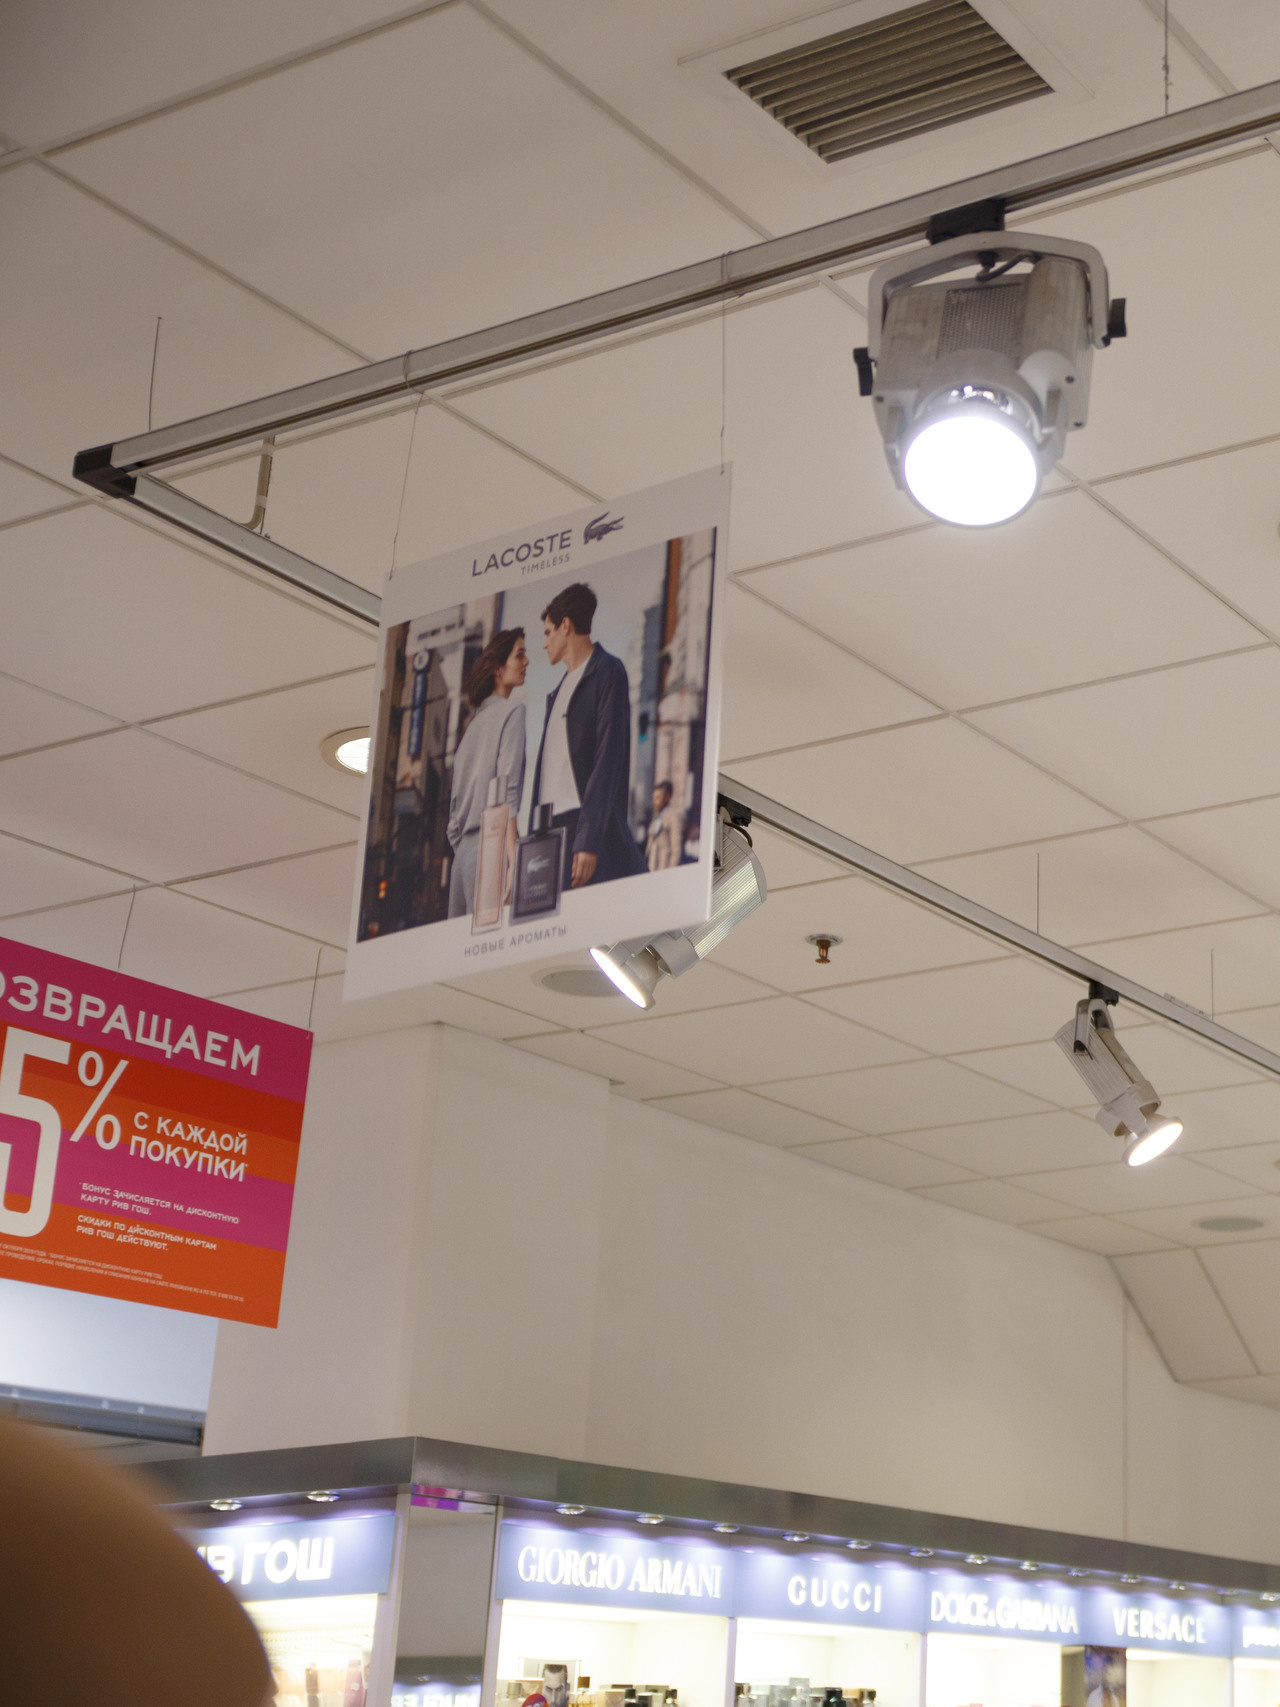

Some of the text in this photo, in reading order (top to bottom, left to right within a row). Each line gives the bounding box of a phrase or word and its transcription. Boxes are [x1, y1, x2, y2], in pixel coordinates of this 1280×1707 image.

[471, 529, 573, 577] LACOSTE
[521, 553, 571, 575] TIMELESS
[464, 925, 568, 957] НОВЫЕ АРОМАТЫ
[0, 970, 261, 1076] ЗВРАЩАЕМ
[133, 1111, 248, 1155] С КАЖДОЙ
[80, 1193, 110, 1206] КАРТУ
[112, 1200, 129, 1210] РИВ
[113, 1190, 171, 1209] ЗАЧИСЛЯЕТСЯ
[173, 1203, 184, 1212] НА
[186, 1207, 240, 1224] ДИСКОНТНУЮ
[76, 1225, 94, 1236] РИВ
[96, 1229, 115, 1240] ГОШ
[77, 1214, 111, 1228] СКИДКИ
[114, 1222, 126, 1231] ПО
[185, 1238, 217, 1250] КАРТАМ
[240, 1537, 335, 1585] ГОШ
[517, 1546, 723, 1598] GIORGIO ARMANI
[787, 1574, 882, 1613] GUCCI
[1112, 1607, 1208, 1644] VERSACE
